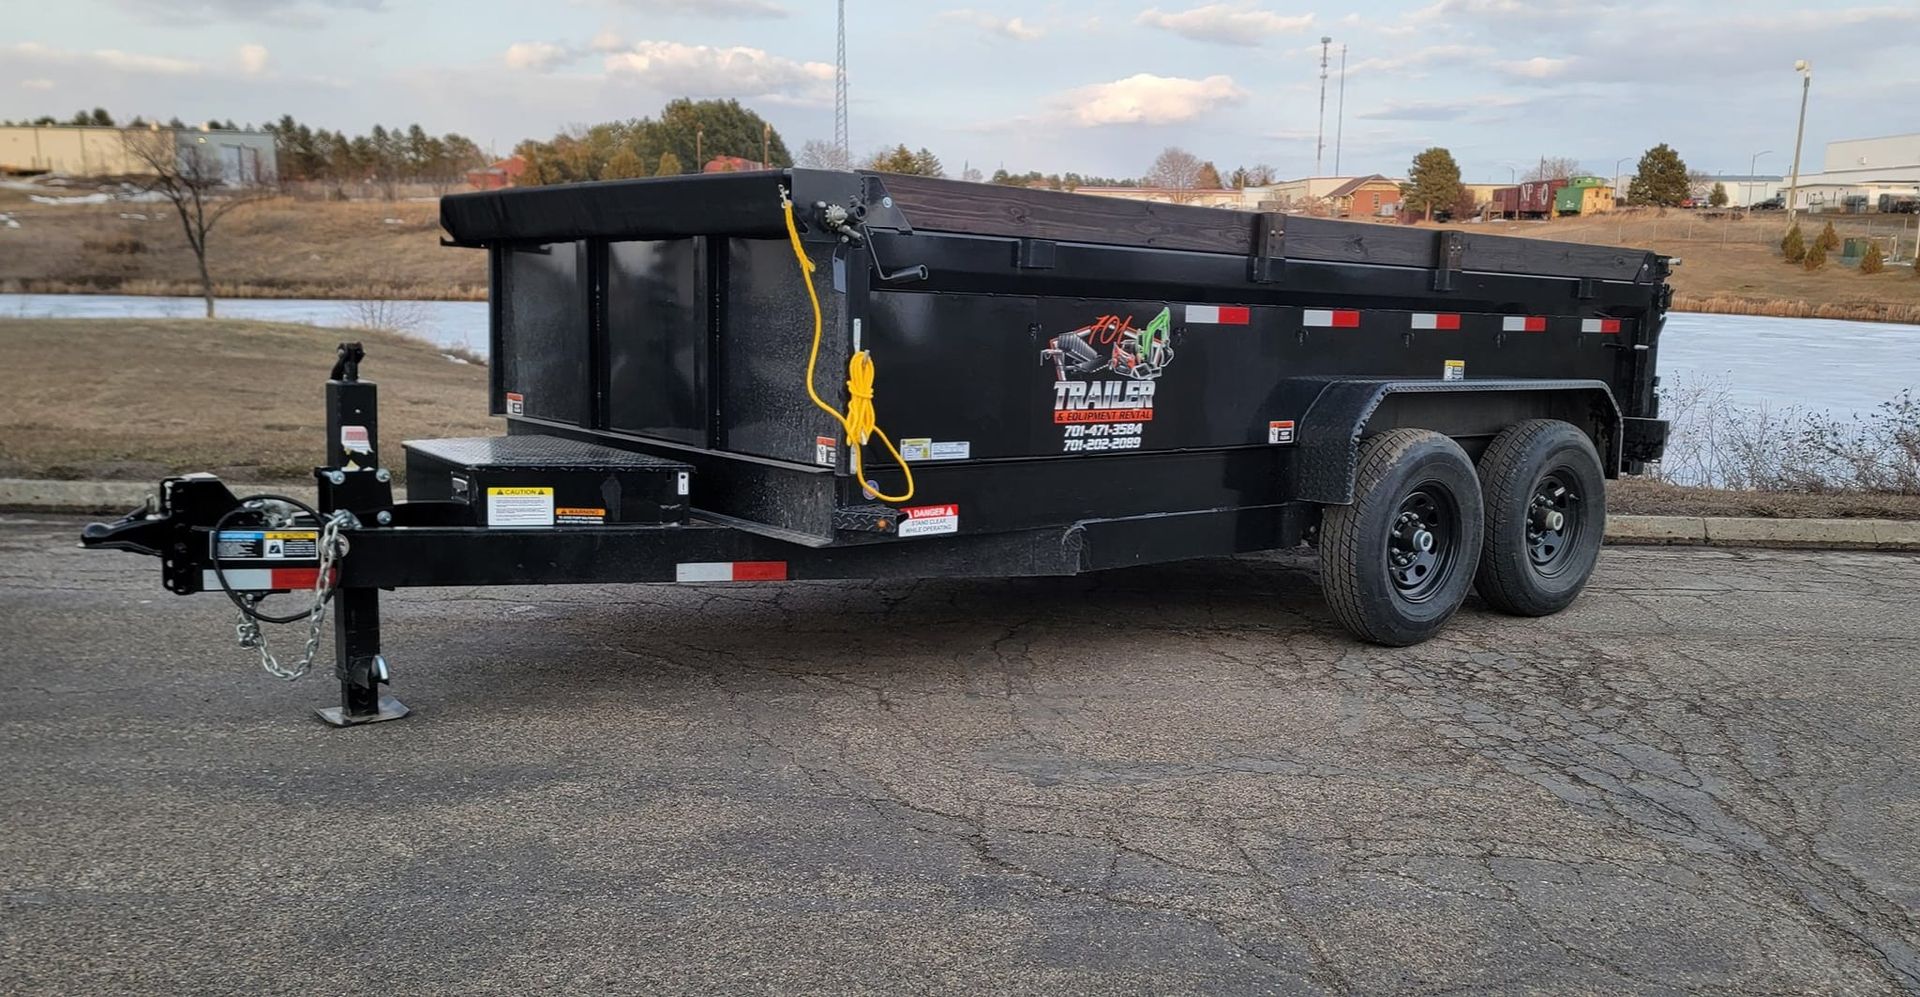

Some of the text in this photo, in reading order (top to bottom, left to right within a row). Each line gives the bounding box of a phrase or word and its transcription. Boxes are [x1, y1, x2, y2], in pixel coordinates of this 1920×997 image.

[1089, 315, 1132, 344] 701
[1054, 381, 1155, 410] TRAILER
[1057, 410, 1151, 421] & EQUIPMENT RENTAL
[1064, 423, 1143, 437] 701-471-3584
[913, 508, 945, 518] DANGER
[923, 524, 952, 532] OPERATING
